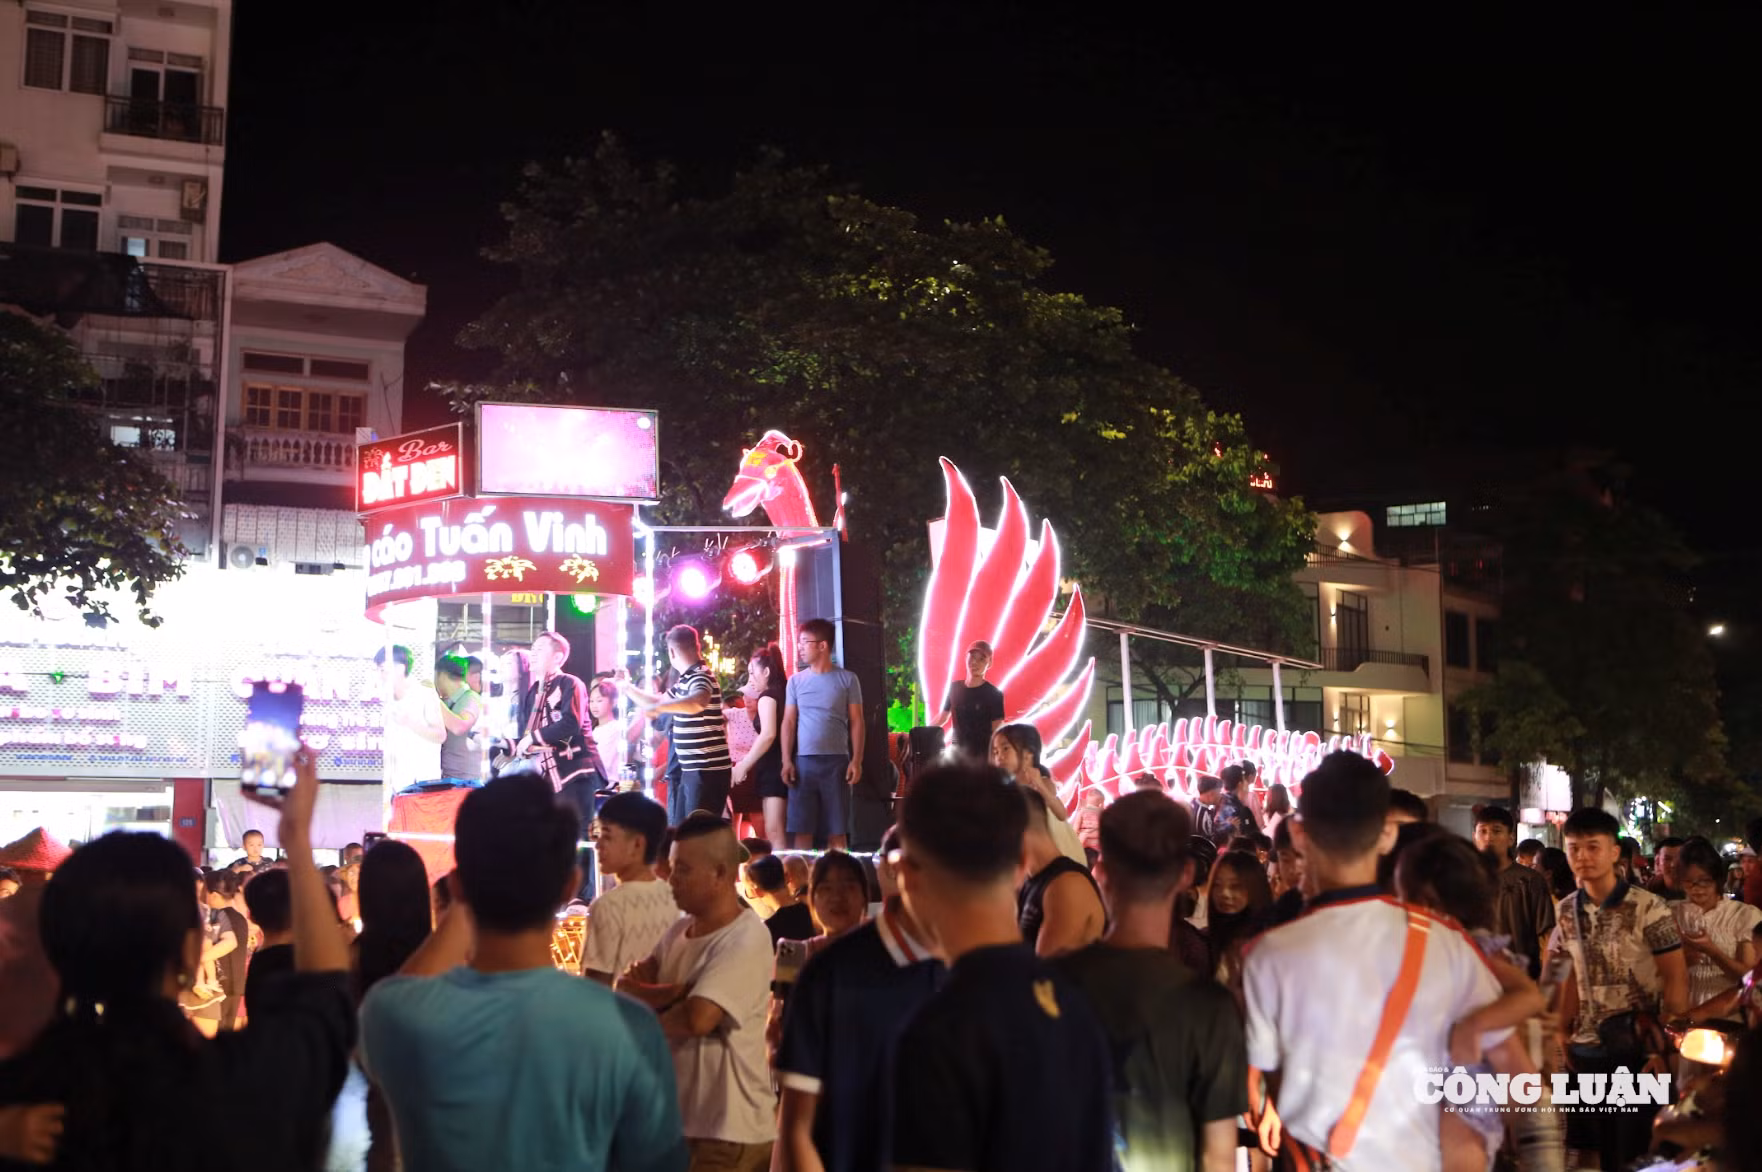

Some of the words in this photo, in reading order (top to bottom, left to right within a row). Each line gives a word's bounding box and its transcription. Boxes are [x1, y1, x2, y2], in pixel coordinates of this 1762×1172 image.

[397, 438, 453, 463] Bar
[420, 505, 513, 558] Tuấn
[523, 511, 608, 556] Vinh
